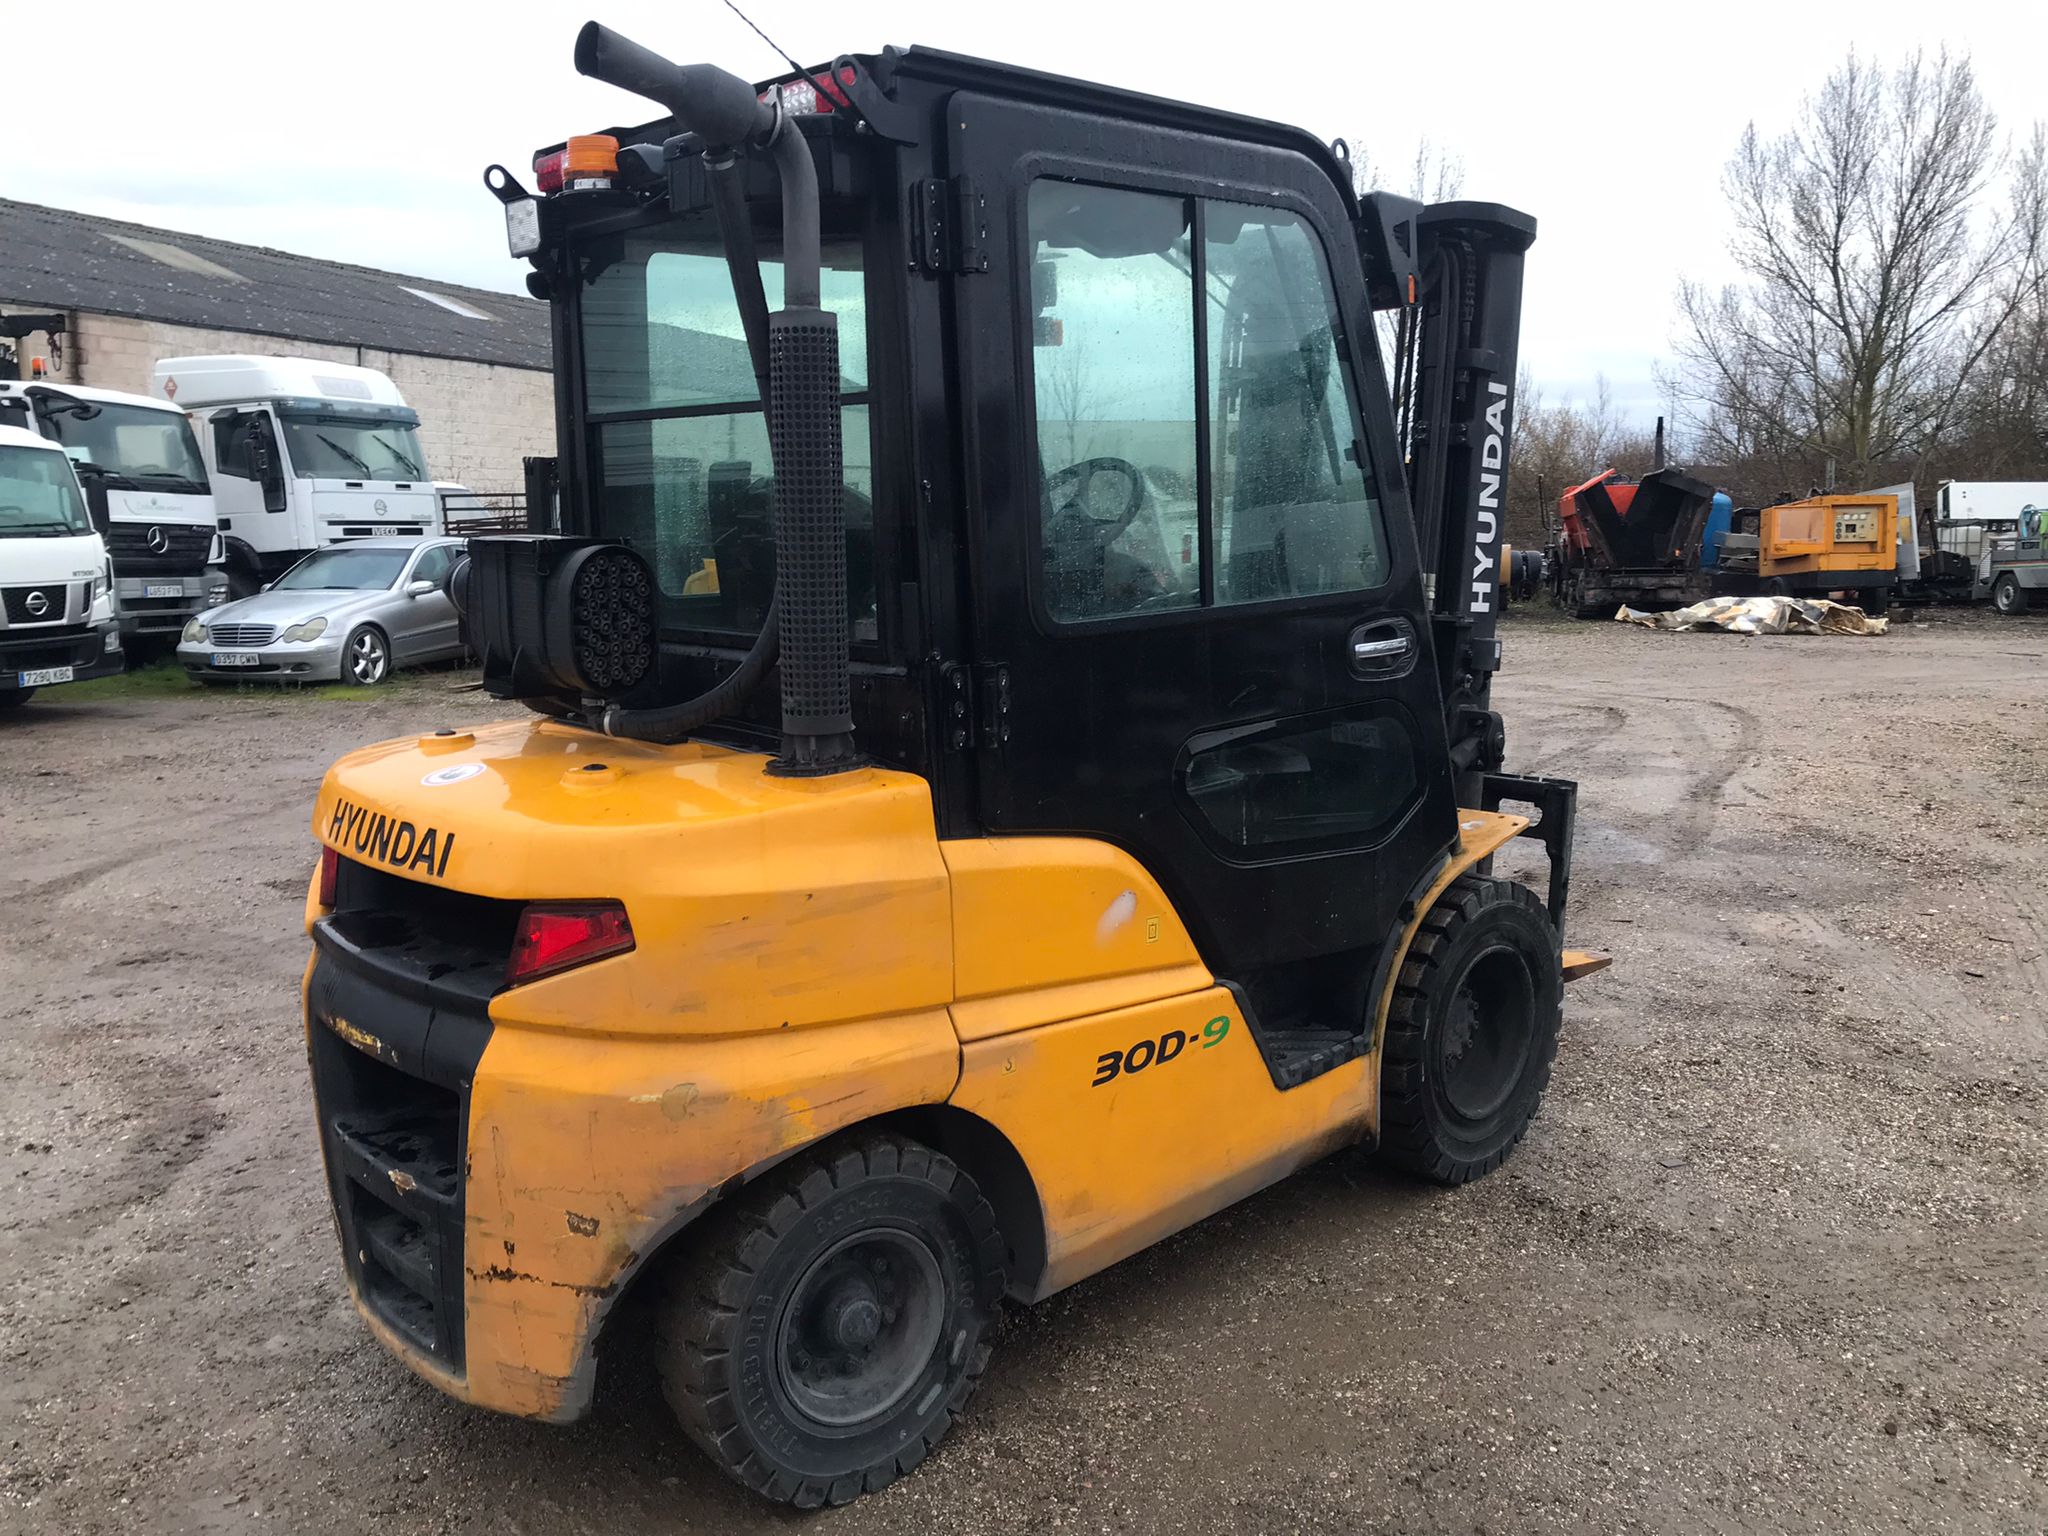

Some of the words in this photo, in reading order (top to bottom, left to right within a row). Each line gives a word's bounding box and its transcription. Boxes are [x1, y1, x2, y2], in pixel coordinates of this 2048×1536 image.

[371, 526, 398, 537] IVECO
[1470, 381, 1508, 613] HYUNDAI
[26, 670, 51, 684] 7290
[329, 798, 456, 878] HYUNDAI
[1091, 1016, 1230, 1088] 30D-9
